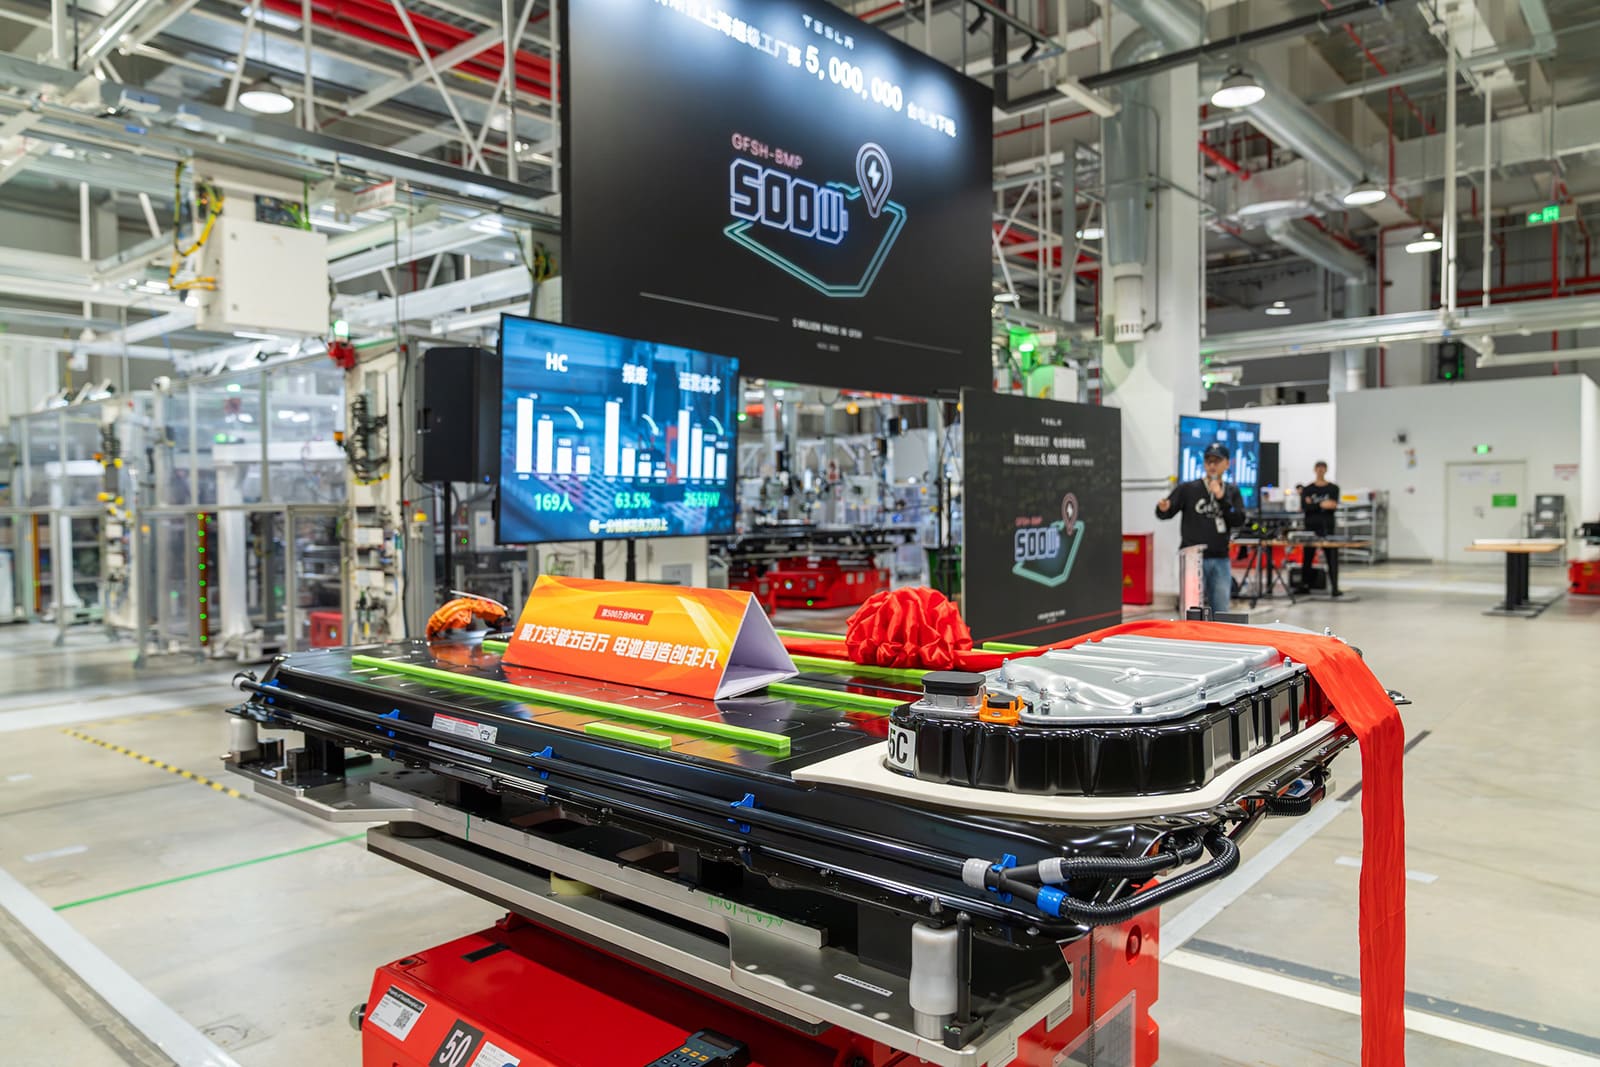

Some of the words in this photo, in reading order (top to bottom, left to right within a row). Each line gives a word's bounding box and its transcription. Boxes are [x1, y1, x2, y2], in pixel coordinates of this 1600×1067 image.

[802, 14, 854, 50] TESLA
[731, 133, 803, 169] GFSH-BMP
[546, 353, 568, 372] HC
[534, 493, 573, 512] 169人
[615, 493, 650, 508] 63.5%
[612, 636, 719, 669] 电池智造创非凡
[439, 1029, 472, 1067] 50
